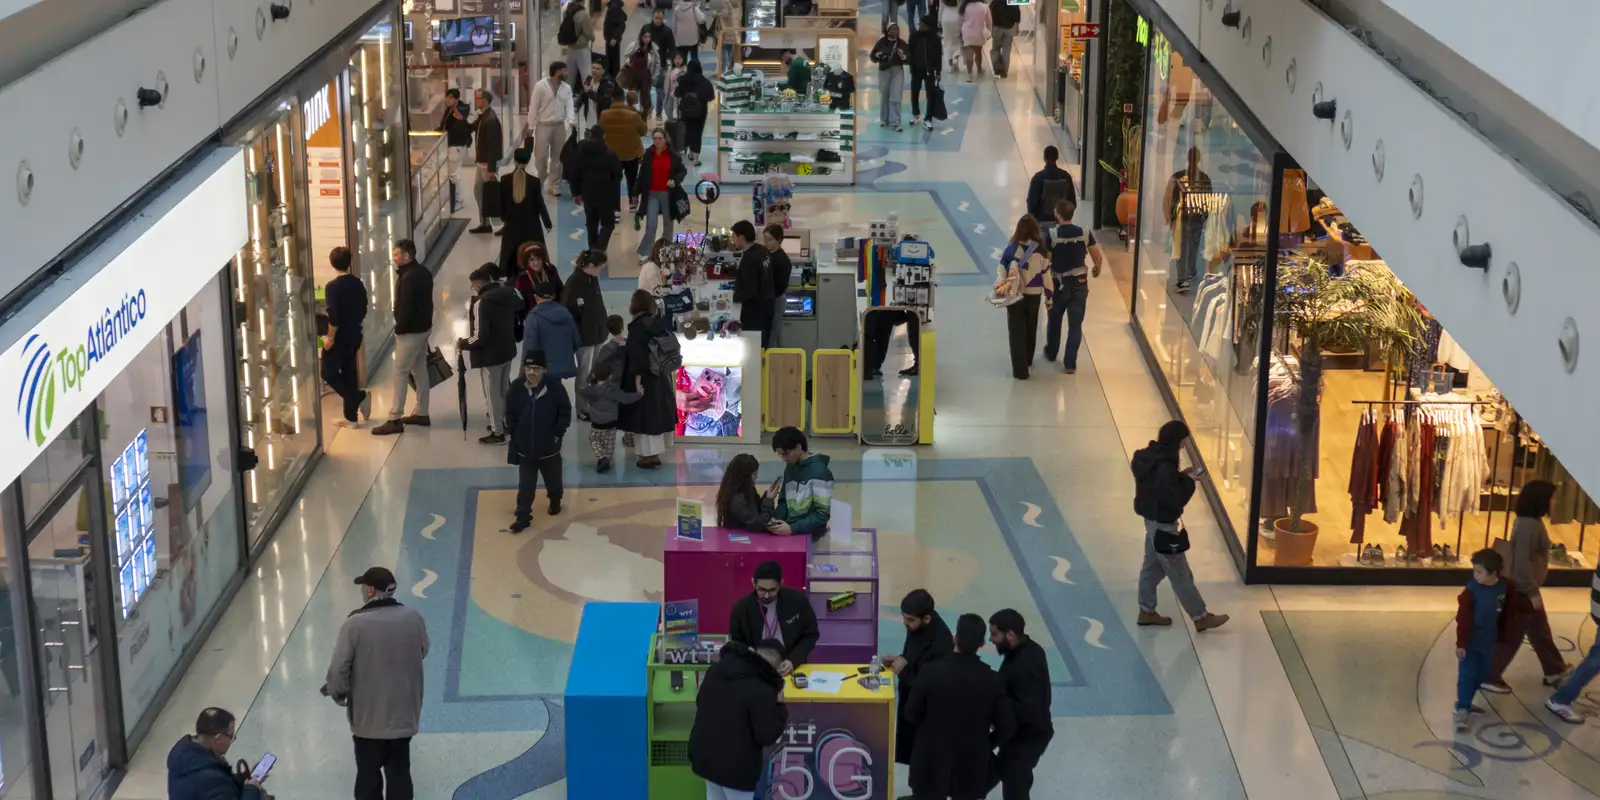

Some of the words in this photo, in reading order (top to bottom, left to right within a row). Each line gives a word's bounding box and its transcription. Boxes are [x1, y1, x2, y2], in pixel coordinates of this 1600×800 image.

[57, 287, 147, 394] TopAtlântico
[666, 647, 715, 664] wtf
[775, 723, 817, 745] tf
[778, 746, 873, 800] 5G
